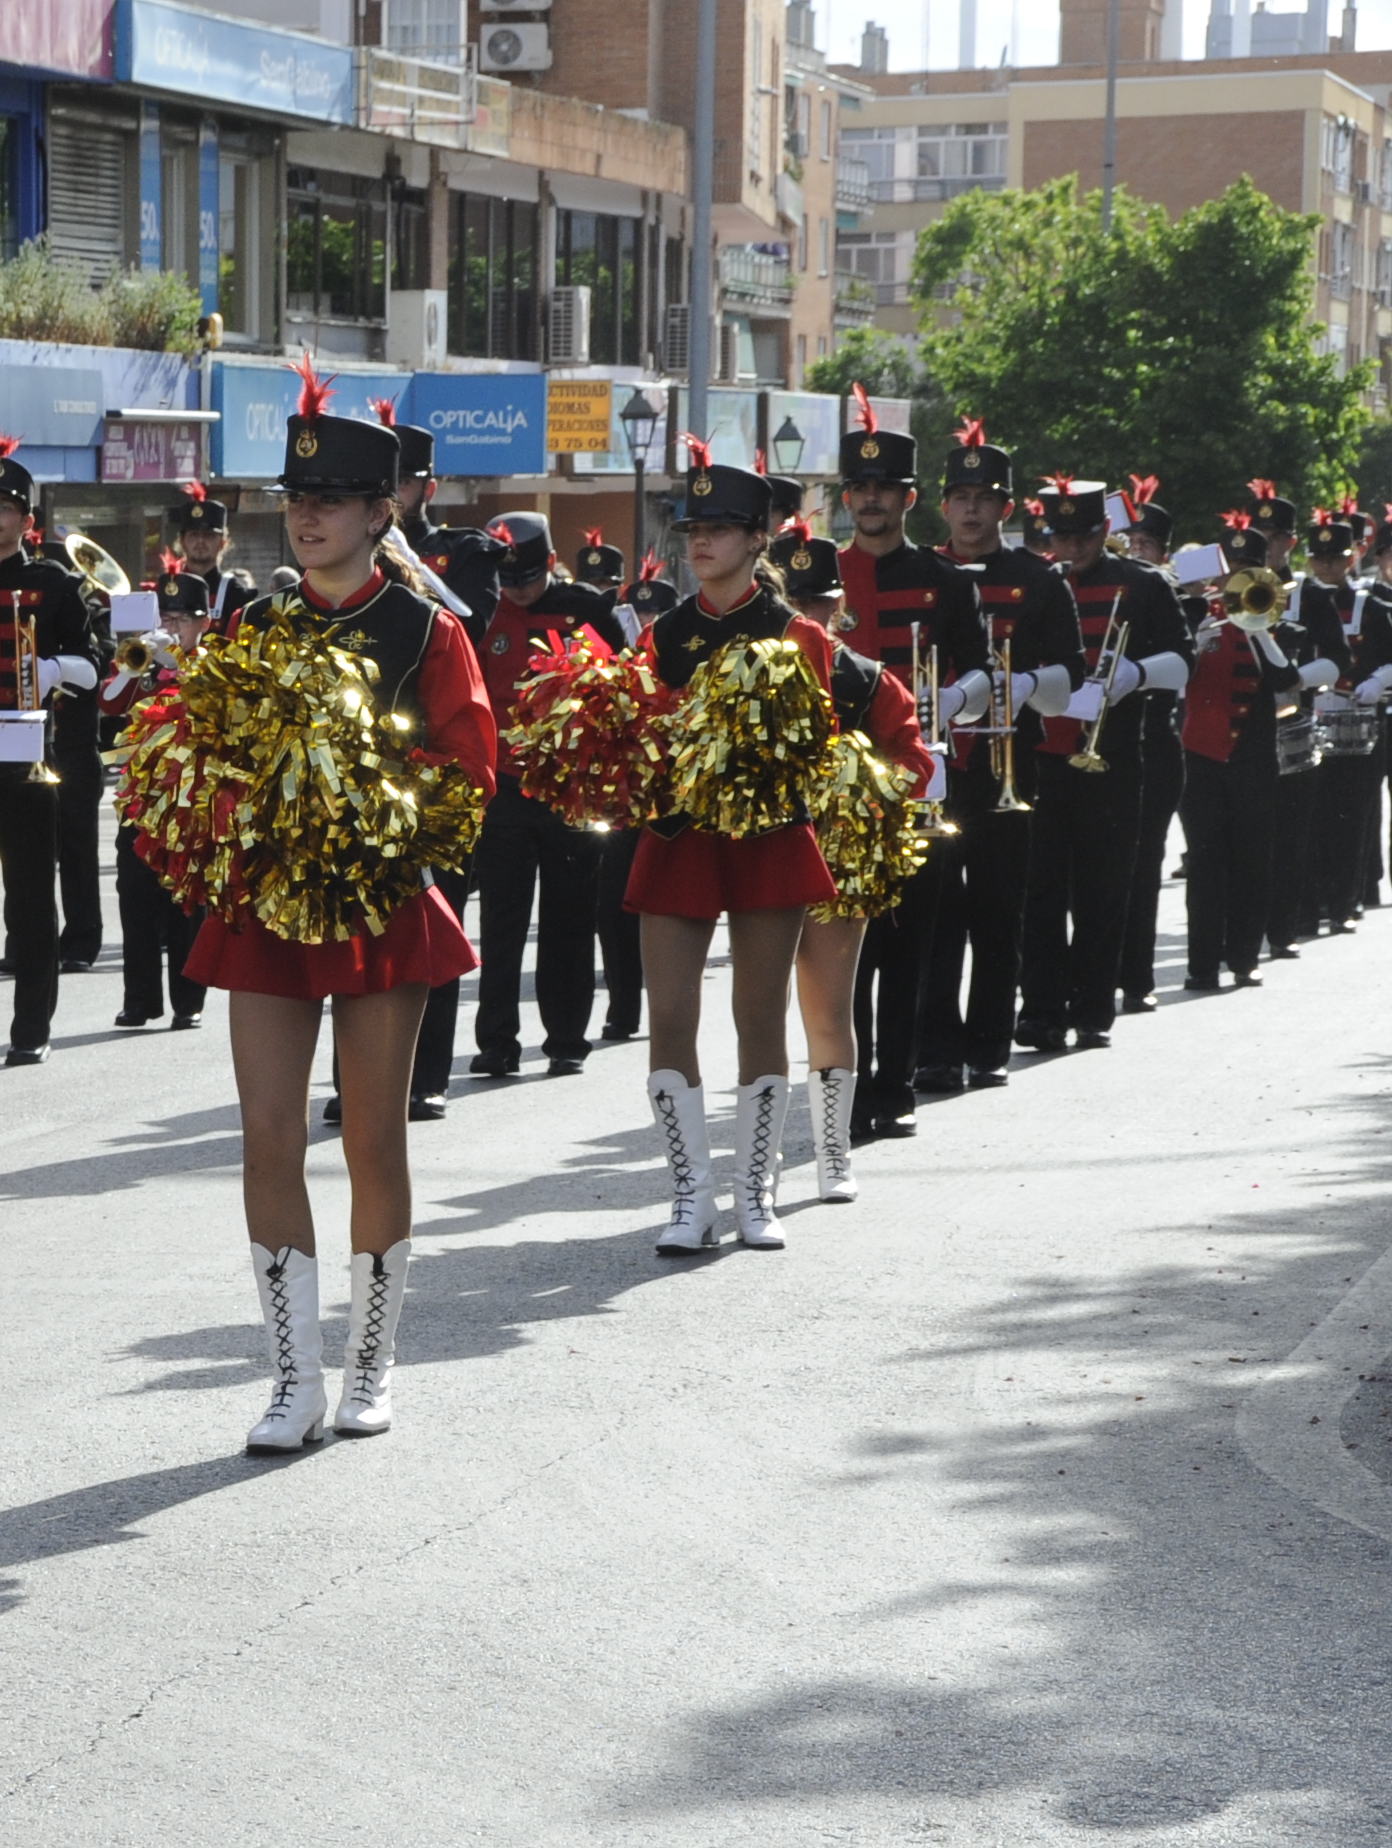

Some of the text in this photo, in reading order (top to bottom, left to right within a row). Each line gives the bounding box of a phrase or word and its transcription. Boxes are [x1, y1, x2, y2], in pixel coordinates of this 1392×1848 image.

[549, 383, 608, 398] CTIVIDAD
[549, 401, 591, 415] DIOMAS
[548, 419, 608, 432] PERACIONES
